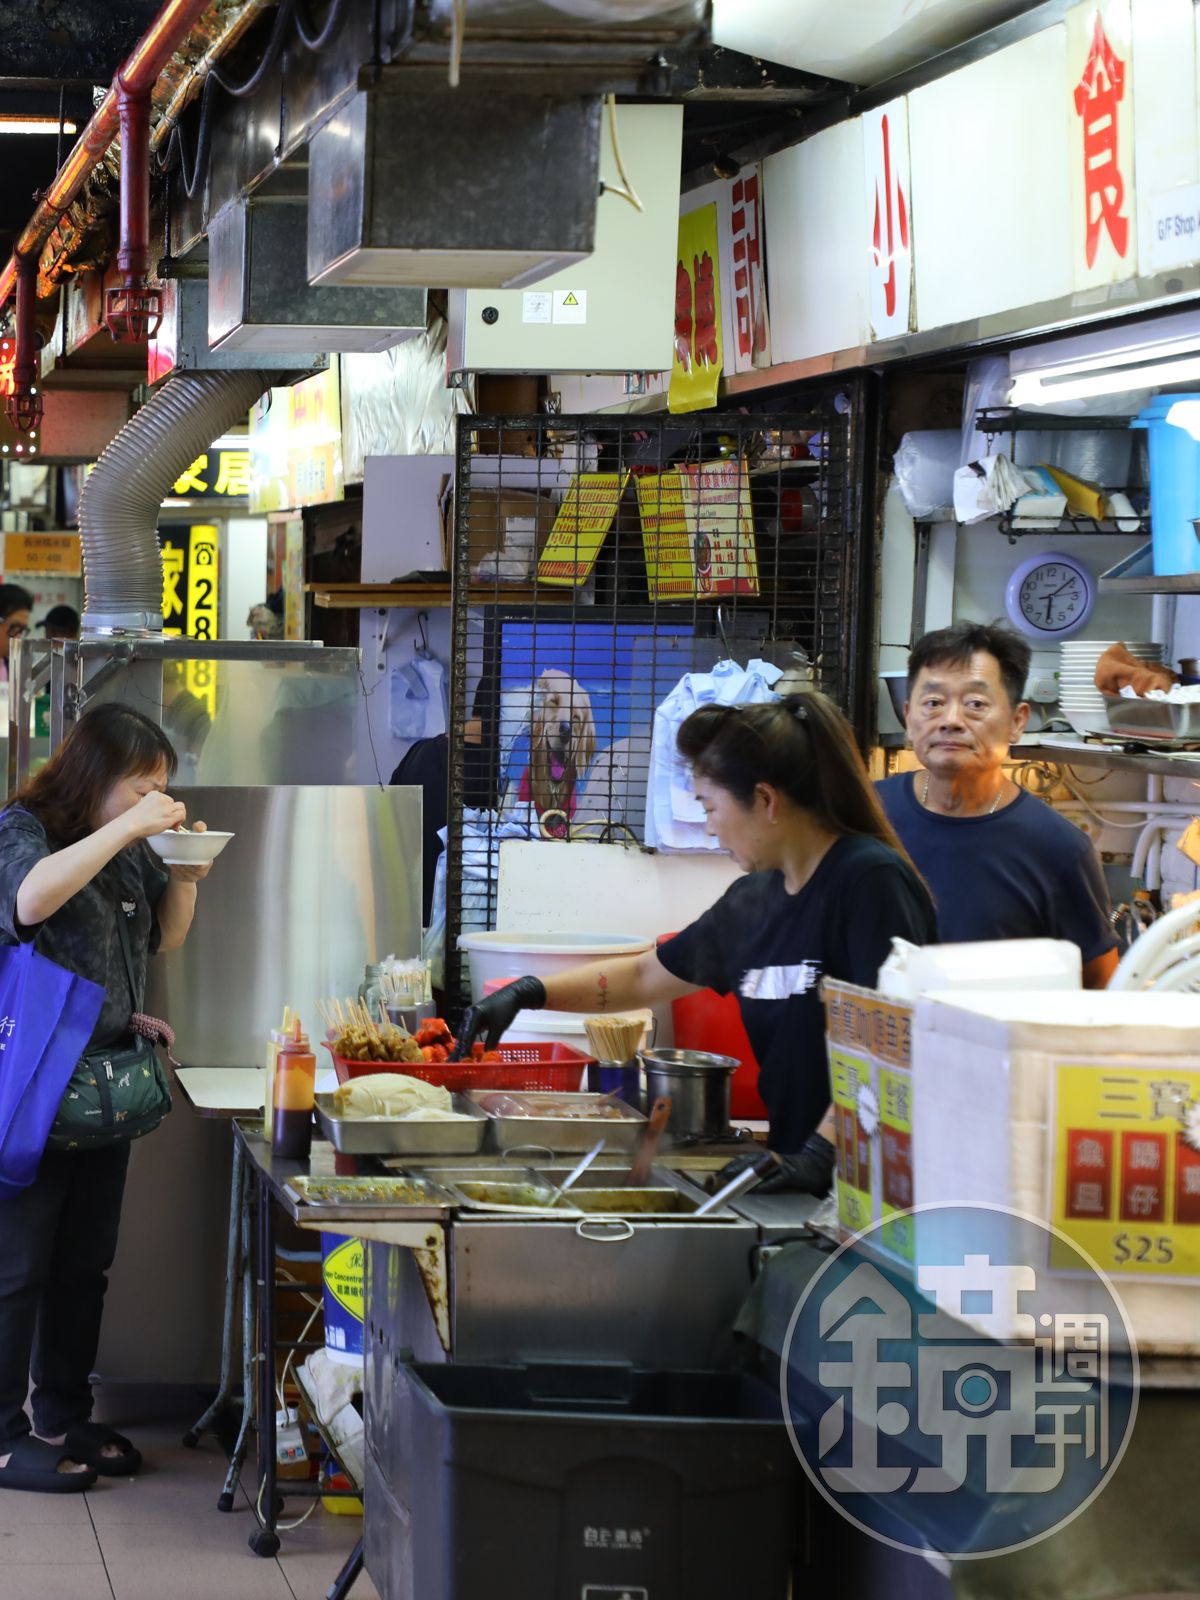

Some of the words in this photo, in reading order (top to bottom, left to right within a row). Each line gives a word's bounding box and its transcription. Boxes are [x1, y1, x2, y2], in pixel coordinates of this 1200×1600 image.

[873, 113, 908, 317] 小
[1073, 10, 1129, 271] 食
[1175, 214, 1196, 239] Shop
[1036, 572, 1043, 580] 11
[1047, 568, 1057, 577] 12
[1026, 581, 1037, 590] 10
[1022, 592, 1031, 602] 9
[1071, 591, 1079, 600] 3
[1025, 604, 1033, 613] 8
[1067, 603, 1074, 611] 4
[1035, 612, 1042, 621] 7
[1058, 612, 1066, 621] 5
[1113, 1232, 1174, 1265] $25
